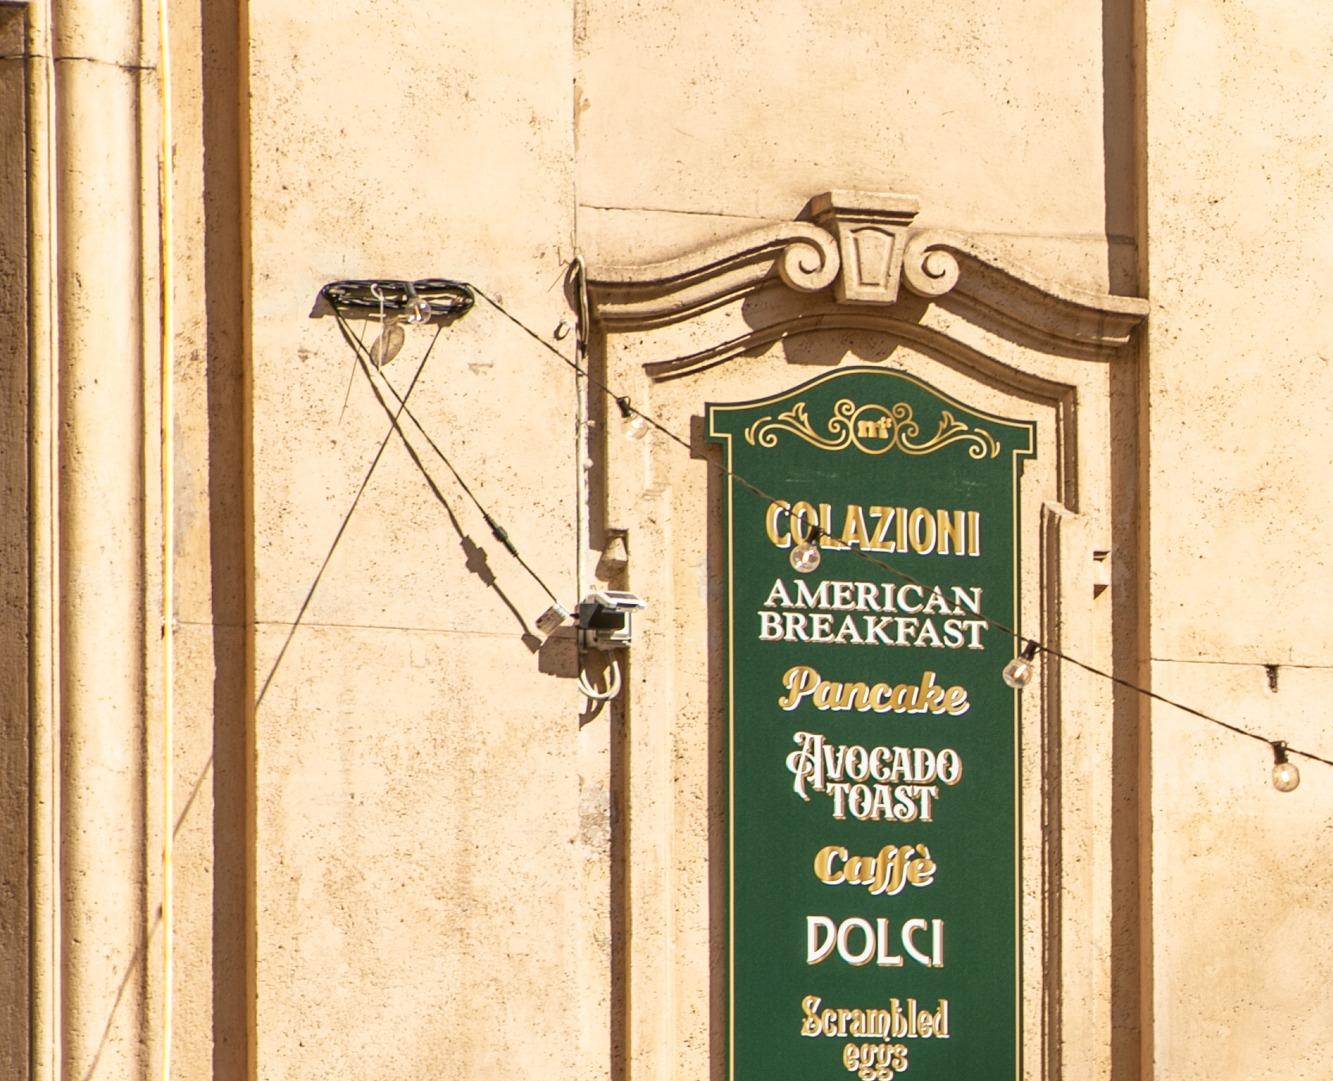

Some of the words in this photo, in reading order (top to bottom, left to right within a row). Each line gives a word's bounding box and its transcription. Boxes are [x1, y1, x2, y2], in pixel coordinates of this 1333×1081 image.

[765, 500, 980, 557] COLAZIONI
[763, 579, 982, 616] AMERICAN
[758, 610, 988, 650] BREAKFAST
[778, 665, 970, 714] Pancake
[786, 731, 962, 801] AVOCADO
[826, 782, 939, 822] TOAST
[813, 843, 937, 895] Caffè
[806, 915, 944, 968] DOLCI
[801, 994, 950, 1042] Scrambled
[843, 1042, 908, 1081] eggs
